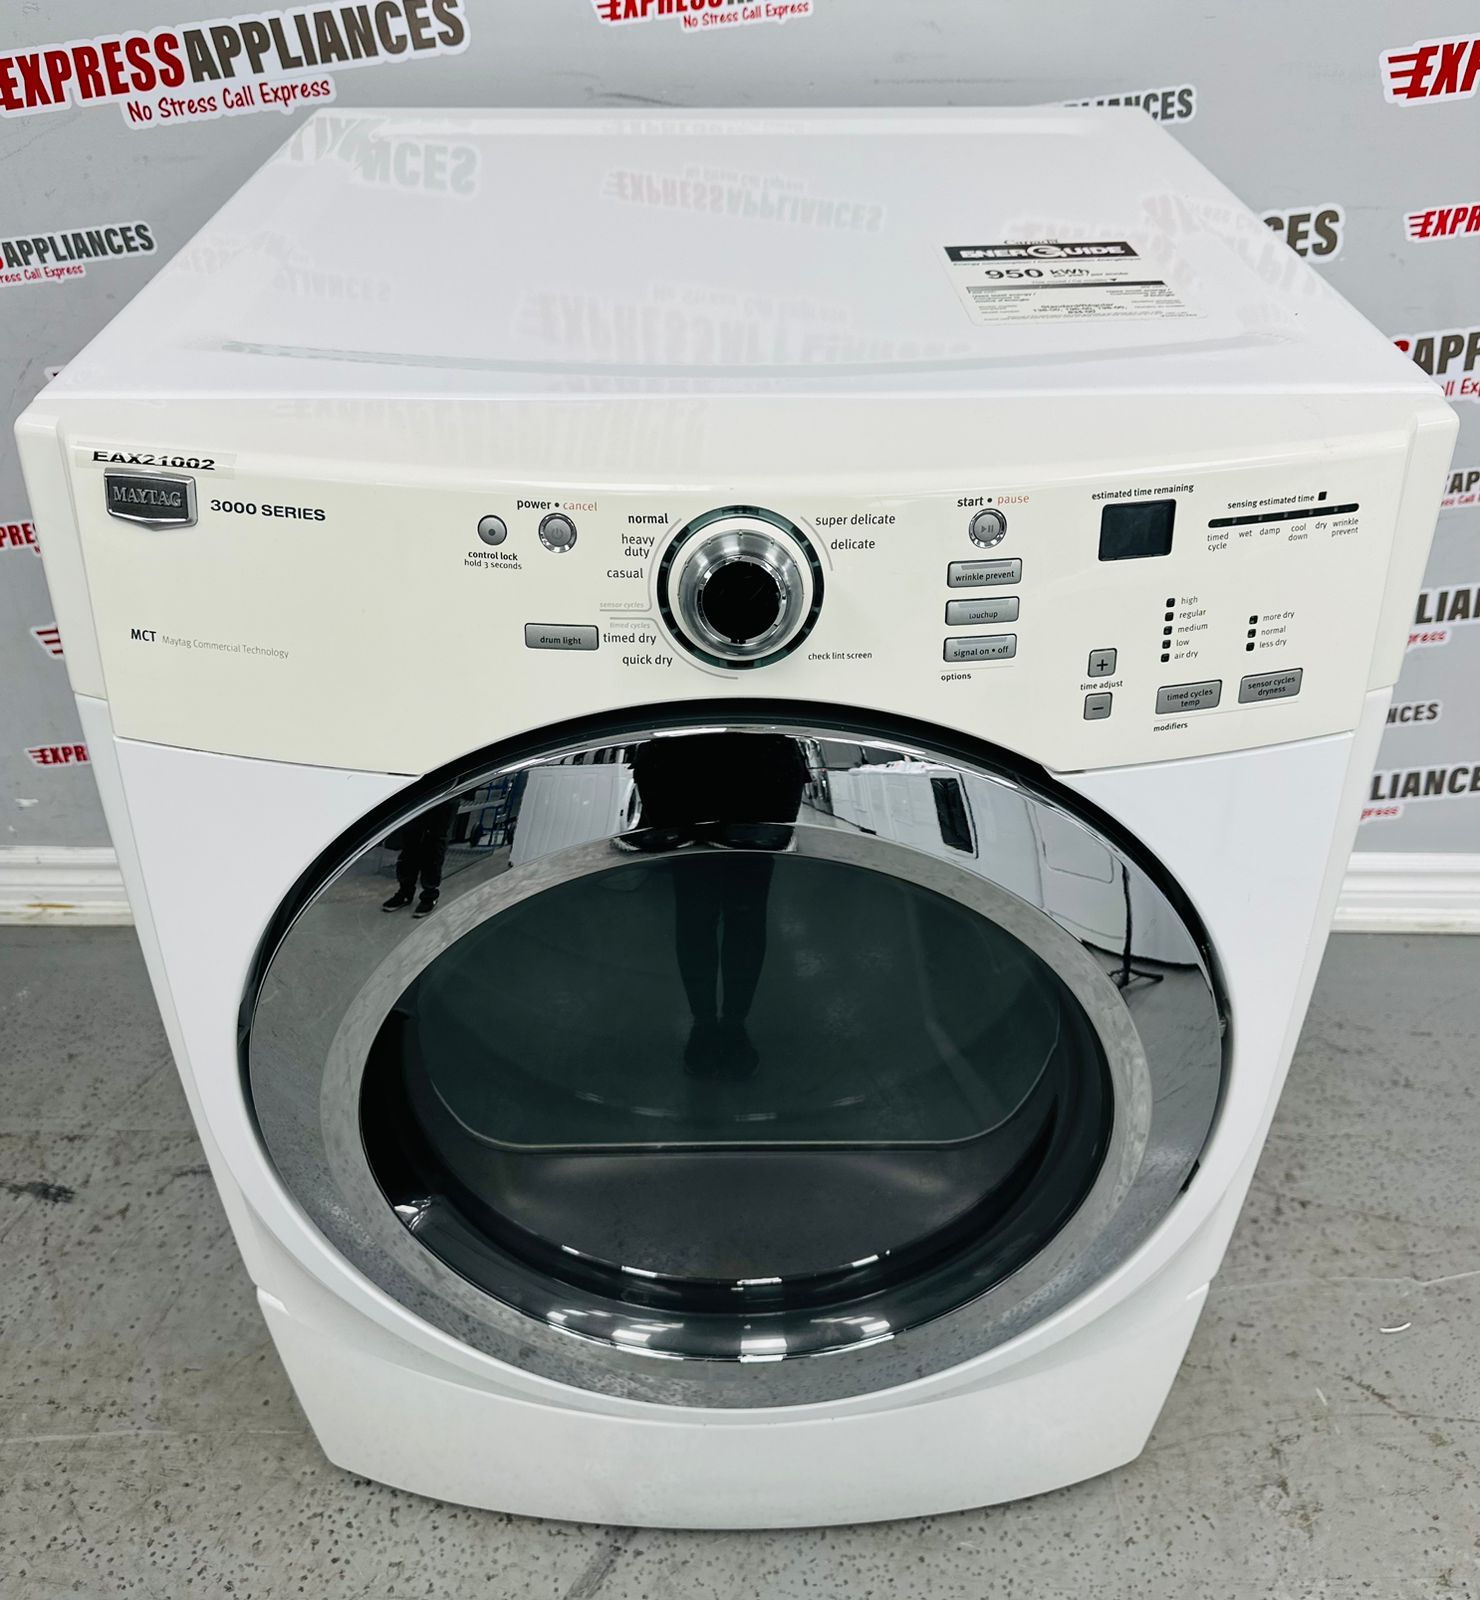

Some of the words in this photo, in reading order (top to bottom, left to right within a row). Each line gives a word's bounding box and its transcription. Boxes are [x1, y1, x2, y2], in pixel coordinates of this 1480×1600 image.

[684, 15, 698, 28] No
[702, 12, 739, 26] Stress
[742, 8, 761, 20] Call
[766, 2, 809, 19] Express
[127, 101, 153, 122] No
[158, 95, 218, 118] Stress
[222, 85, 255, 109] Call
[259, 80, 331, 107] Express
[24, 269, 42, 280] Call
[45, 265, 83, 280] Express
[985, 268, 1043, 279] 950
[1050, 268, 1090, 276] kWh
[93, 450, 216, 471] EAX21002
[112, 486, 182, 507] MAYTAG
[1091, 489, 1132, 501] estimated
[1133, 487, 1152, 497] time
[1153, 484, 1194, 496] remaining
[517, 500, 551, 511] power
[563, 501, 598, 512] cancel
[957, 496, 984, 508] start
[997, 494, 1030, 506] pause
[1227, 499, 1258, 510] sensing
[1259, 495, 1297, 506] estimated
[1297, 494, 1315, 503] time
[210, 499, 257, 515] 3000
[261, 504, 326, 521] SERIES
[628, 513, 668, 524] normal
[815, 515, 848, 527] super
[850, 514, 896, 526] delicate
[1332, 517, 1359, 528] wrinkle
[1290, 523, 1307, 533] cool
[1315, 520, 1328, 531] dry
[1207, 532, 1229, 542] timed
[1238, 529, 1253, 538] wet
[1259, 526, 1281, 537] damp
[1288, 532, 1308, 542] down
[1331, 527, 1359, 538] prevent
[621, 533, 655, 547] heavy
[830, 538, 876, 550] delicate
[1208, 542, 1228, 551] cycle
[468, 551, 498, 560] control
[500, 552, 518, 561] lock
[624, 547, 650, 560] duty
[464, 559, 481, 568] hold
[484, 561, 489, 569] 3
[490, 561, 522, 570] seconds
[606, 568, 644, 579] casual
[955, 572, 984, 582] wrinkle
[985, 570, 1015, 581] prevent
[1180, 596, 1198, 606] high
[1179, 608, 1207, 620] regular
[1262, 613, 1281, 622] more
[1281, 611, 1295, 621] dry
[1177, 622, 1208, 633] medium
[1261, 626, 1287, 636] normal
[130, 628, 157, 643] MCT
[162, 635, 191, 649] Maytag
[193, 638, 241, 653] Commercial
[242, 644, 289, 659] Technology
[540, 635, 561, 644] drum
[563, 635, 581, 646] light
[603, 632, 636, 643] timed
[638, 633, 657, 645] dry
[1176, 638, 1190, 647] low
[1259, 640, 1273, 649] less
[1274, 638, 1287, 648] dry
[808, 652, 830, 661] check
[832, 651, 845, 660] lint
[846, 652, 873, 660] screen
[954, 646, 978, 658] signal
[979, 647, 990, 656] on
[998, 645, 1009, 655] off
[1174, 651, 1185, 660] air
[1186, 650, 1199, 660] dry
[622, 654, 653, 667] quick
[655, 654, 673, 667] dry
[940, 672, 972, 682] options
[1080, 681, 1098, 691] time
[1099, 680, 1123, 691] adjust
[1247, 680, 1272, 690] sensor
[1273, 676, 1296, 687] cycles
[1167, 691, 1189, 701] timed
[1190, 688, 1213, 699] cycles
[1257, 686, 1286, 697] dryness
[1181, 699, 1200, 708] temp
[1153, 722, 1188, 732] modifiers
